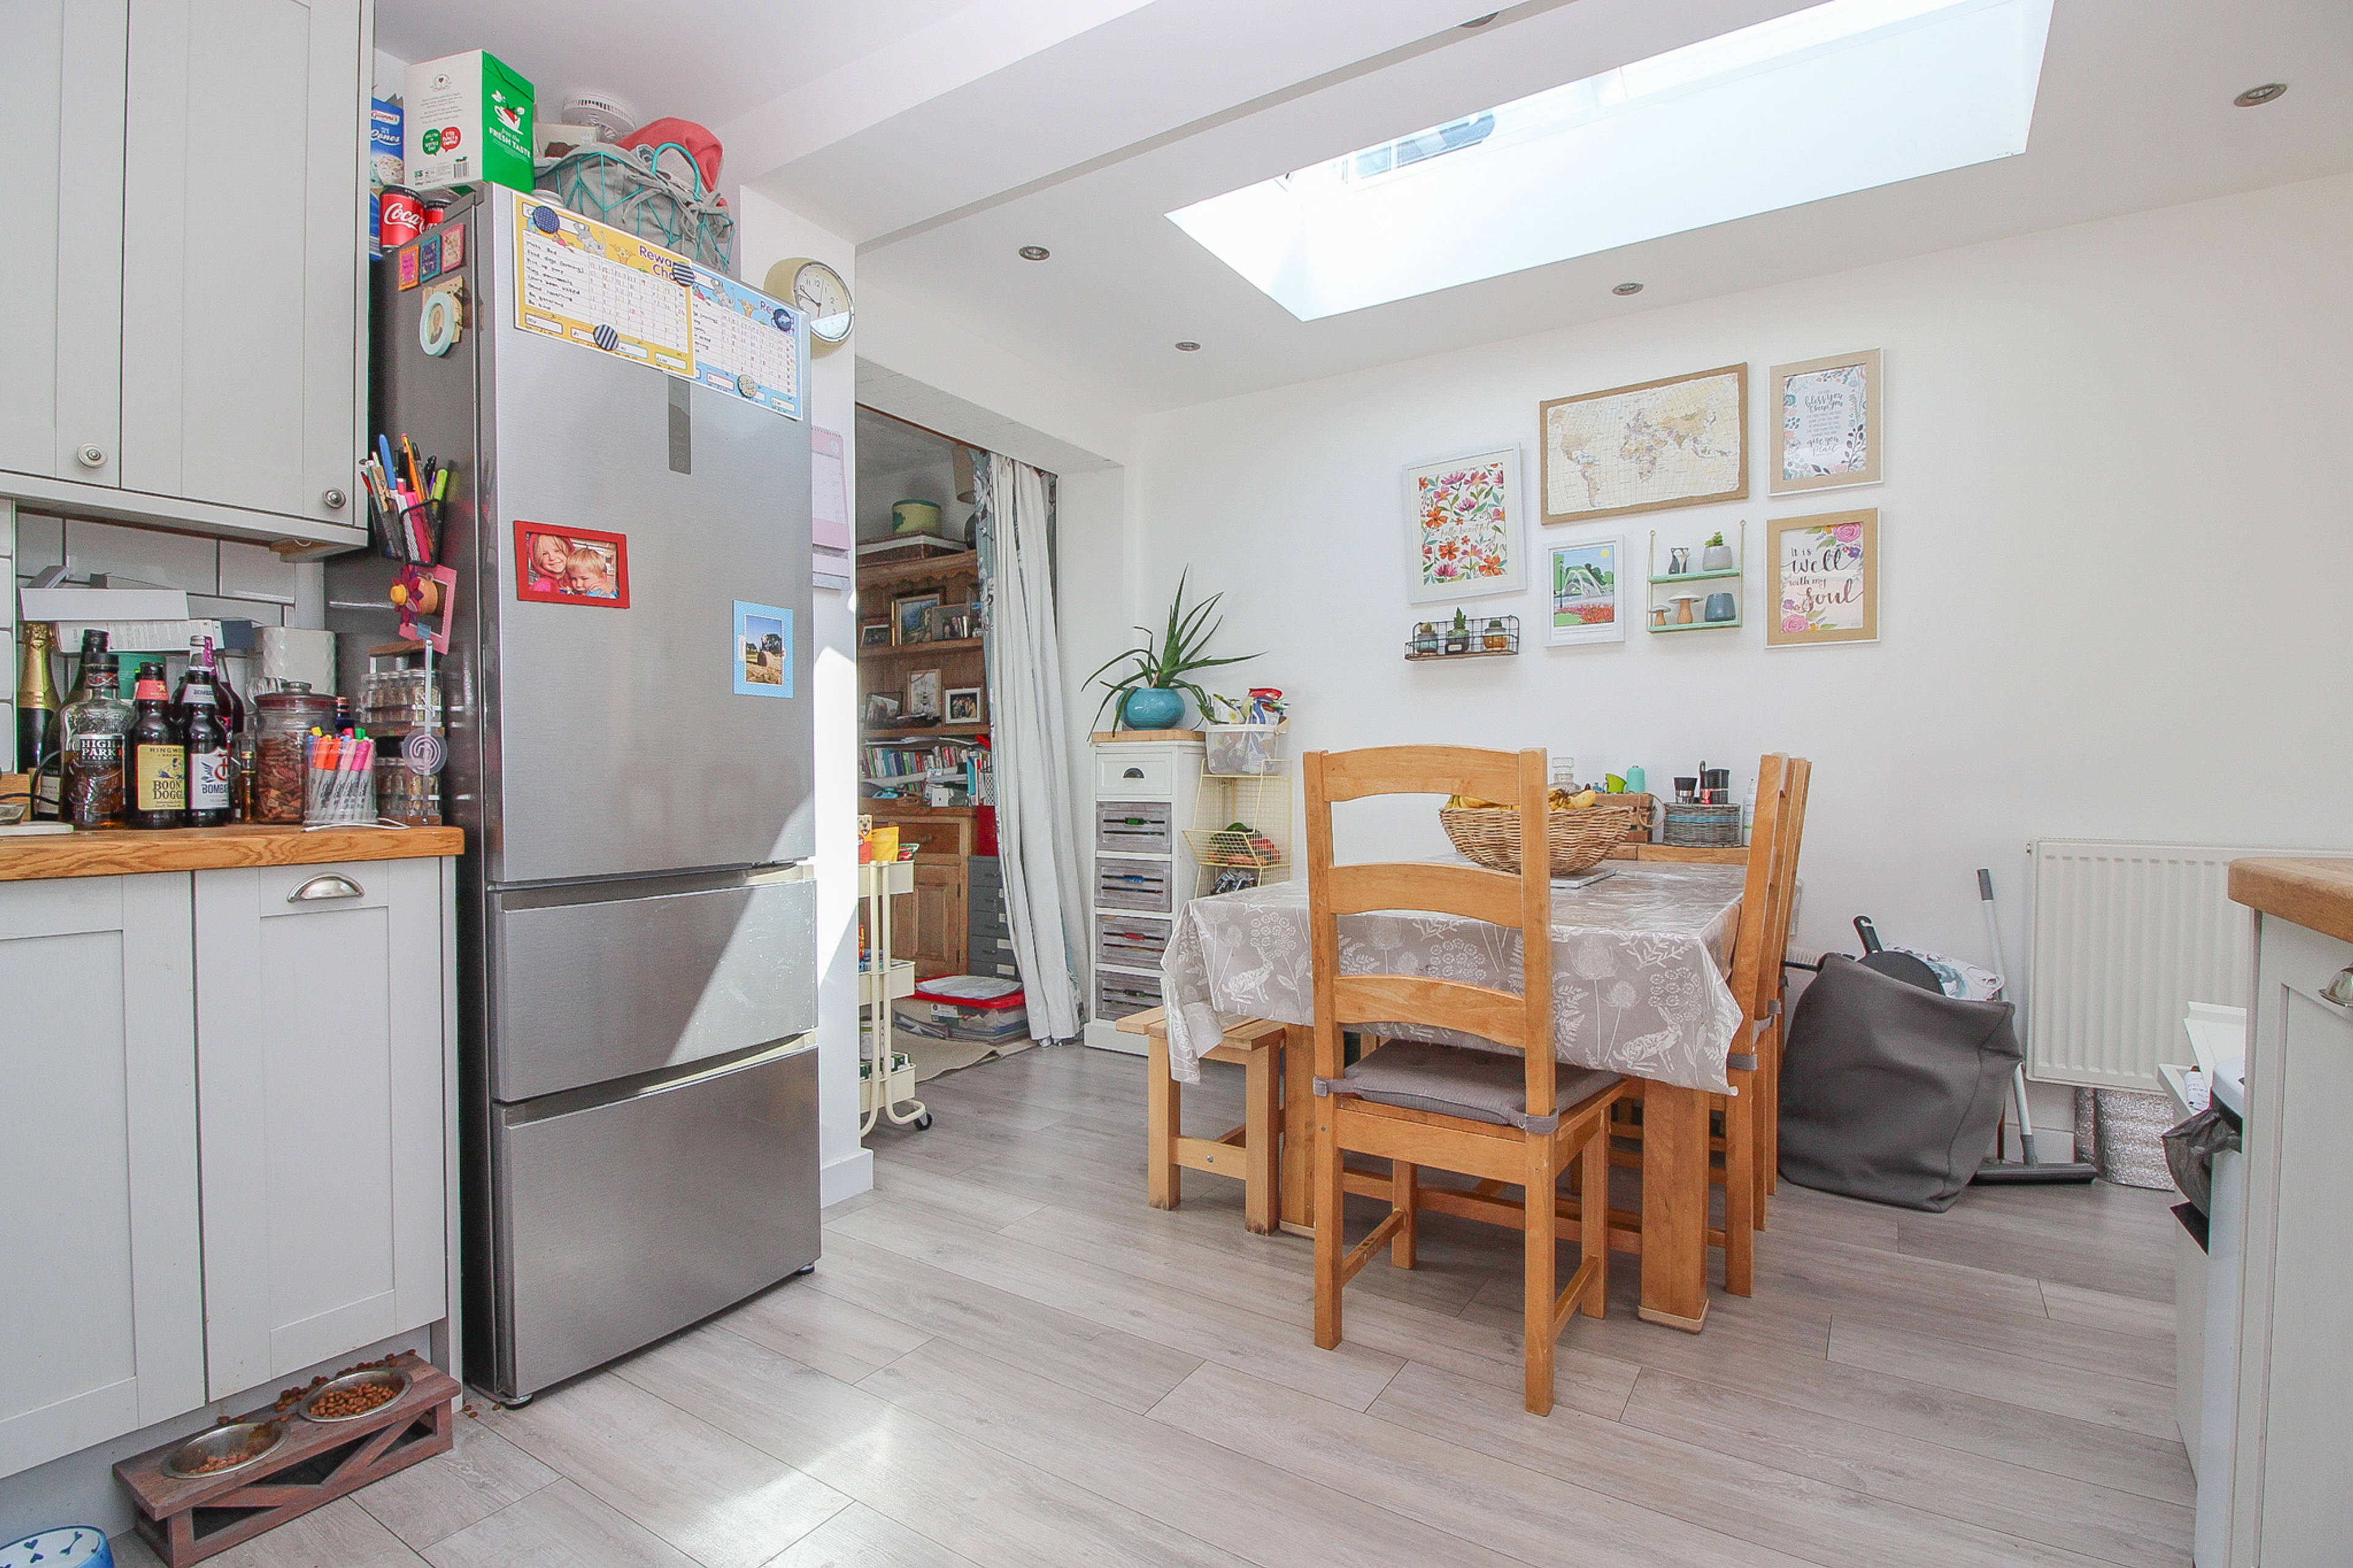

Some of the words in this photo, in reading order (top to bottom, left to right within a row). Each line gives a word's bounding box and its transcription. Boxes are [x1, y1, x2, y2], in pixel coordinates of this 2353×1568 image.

[490, 127, 511, 146] FRESH
[512, 140, 531, 158] TASTE
[640, 245, 675, 267] Rewa
[653, 264, 675, 281] Cha
[1791, 547, 1797, 557] It
[1789, 577, 1809, 586] with
[1812, 578, 1826, 589] my
[81, 748, 116, 757] PARK
